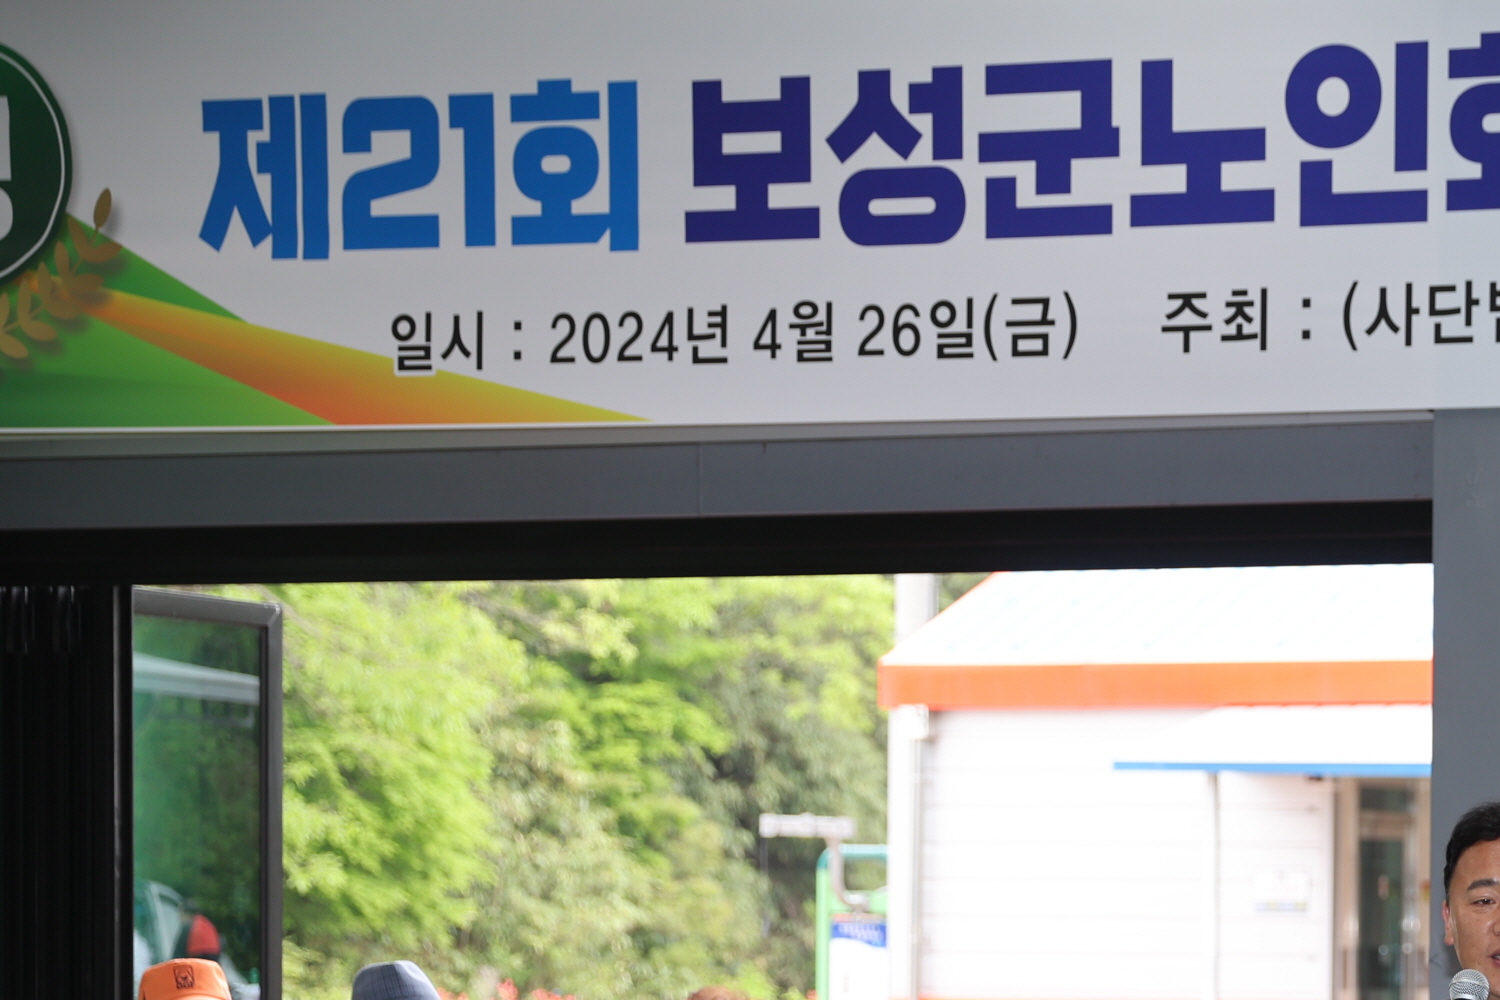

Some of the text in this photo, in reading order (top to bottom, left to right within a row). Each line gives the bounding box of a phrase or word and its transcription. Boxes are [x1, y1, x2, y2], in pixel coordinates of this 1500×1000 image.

[200, 78, 640, 261] 제21회
[391, 310, 485, 371] 일시
[549, 304, 729, 365] 2024년
[753, 300, 834, 363] 4월
[857, 291, 1079, 362] 26일(금)
[1160, 287, 1269, 354] 주최
